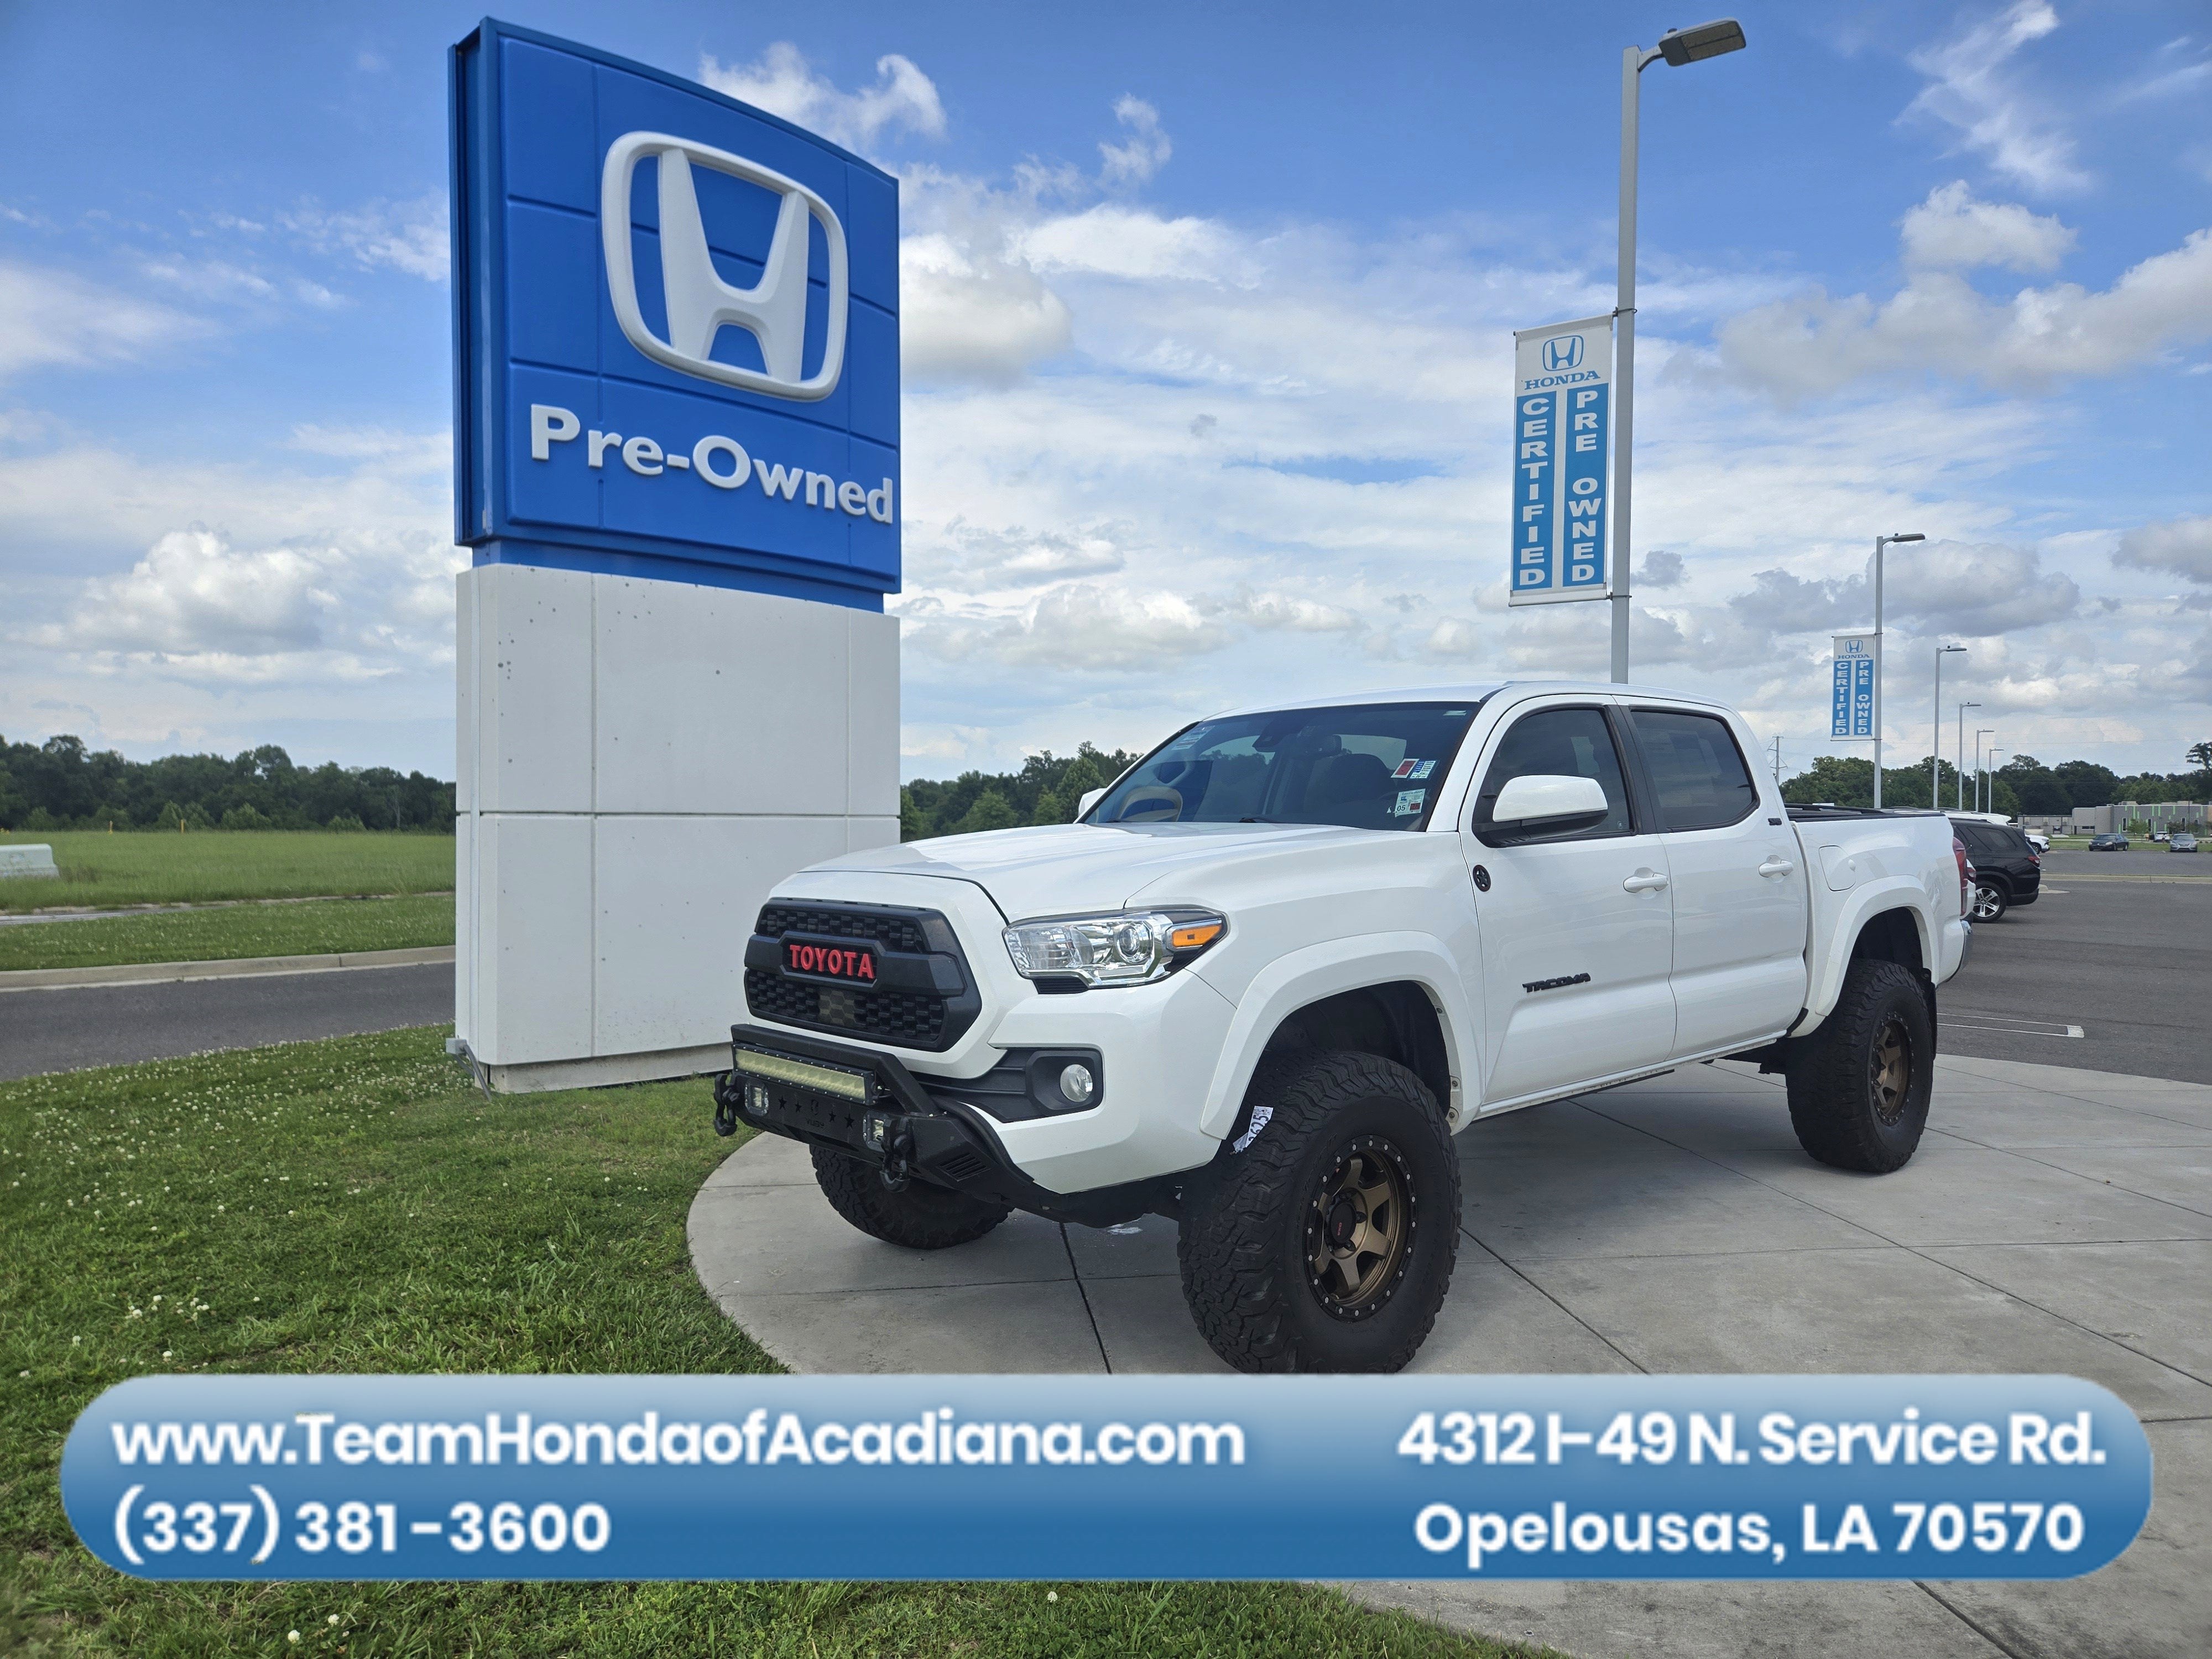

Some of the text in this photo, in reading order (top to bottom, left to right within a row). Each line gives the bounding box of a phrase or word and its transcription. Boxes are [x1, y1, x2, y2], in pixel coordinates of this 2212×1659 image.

[1525, 370, 1601, 390] HONDA
[531, 403, 893, 524] Pre-Owned
[1519, 397, 1550, 586] CERTIFIED
[1568, 390, 1601, 582] PRE OWNED
[1835, 662, 1849, 734] CERTIFIED
[1856, 661, 1871, 734] PRE OWNED
[789, 944, 875, 979] TOYOTA
